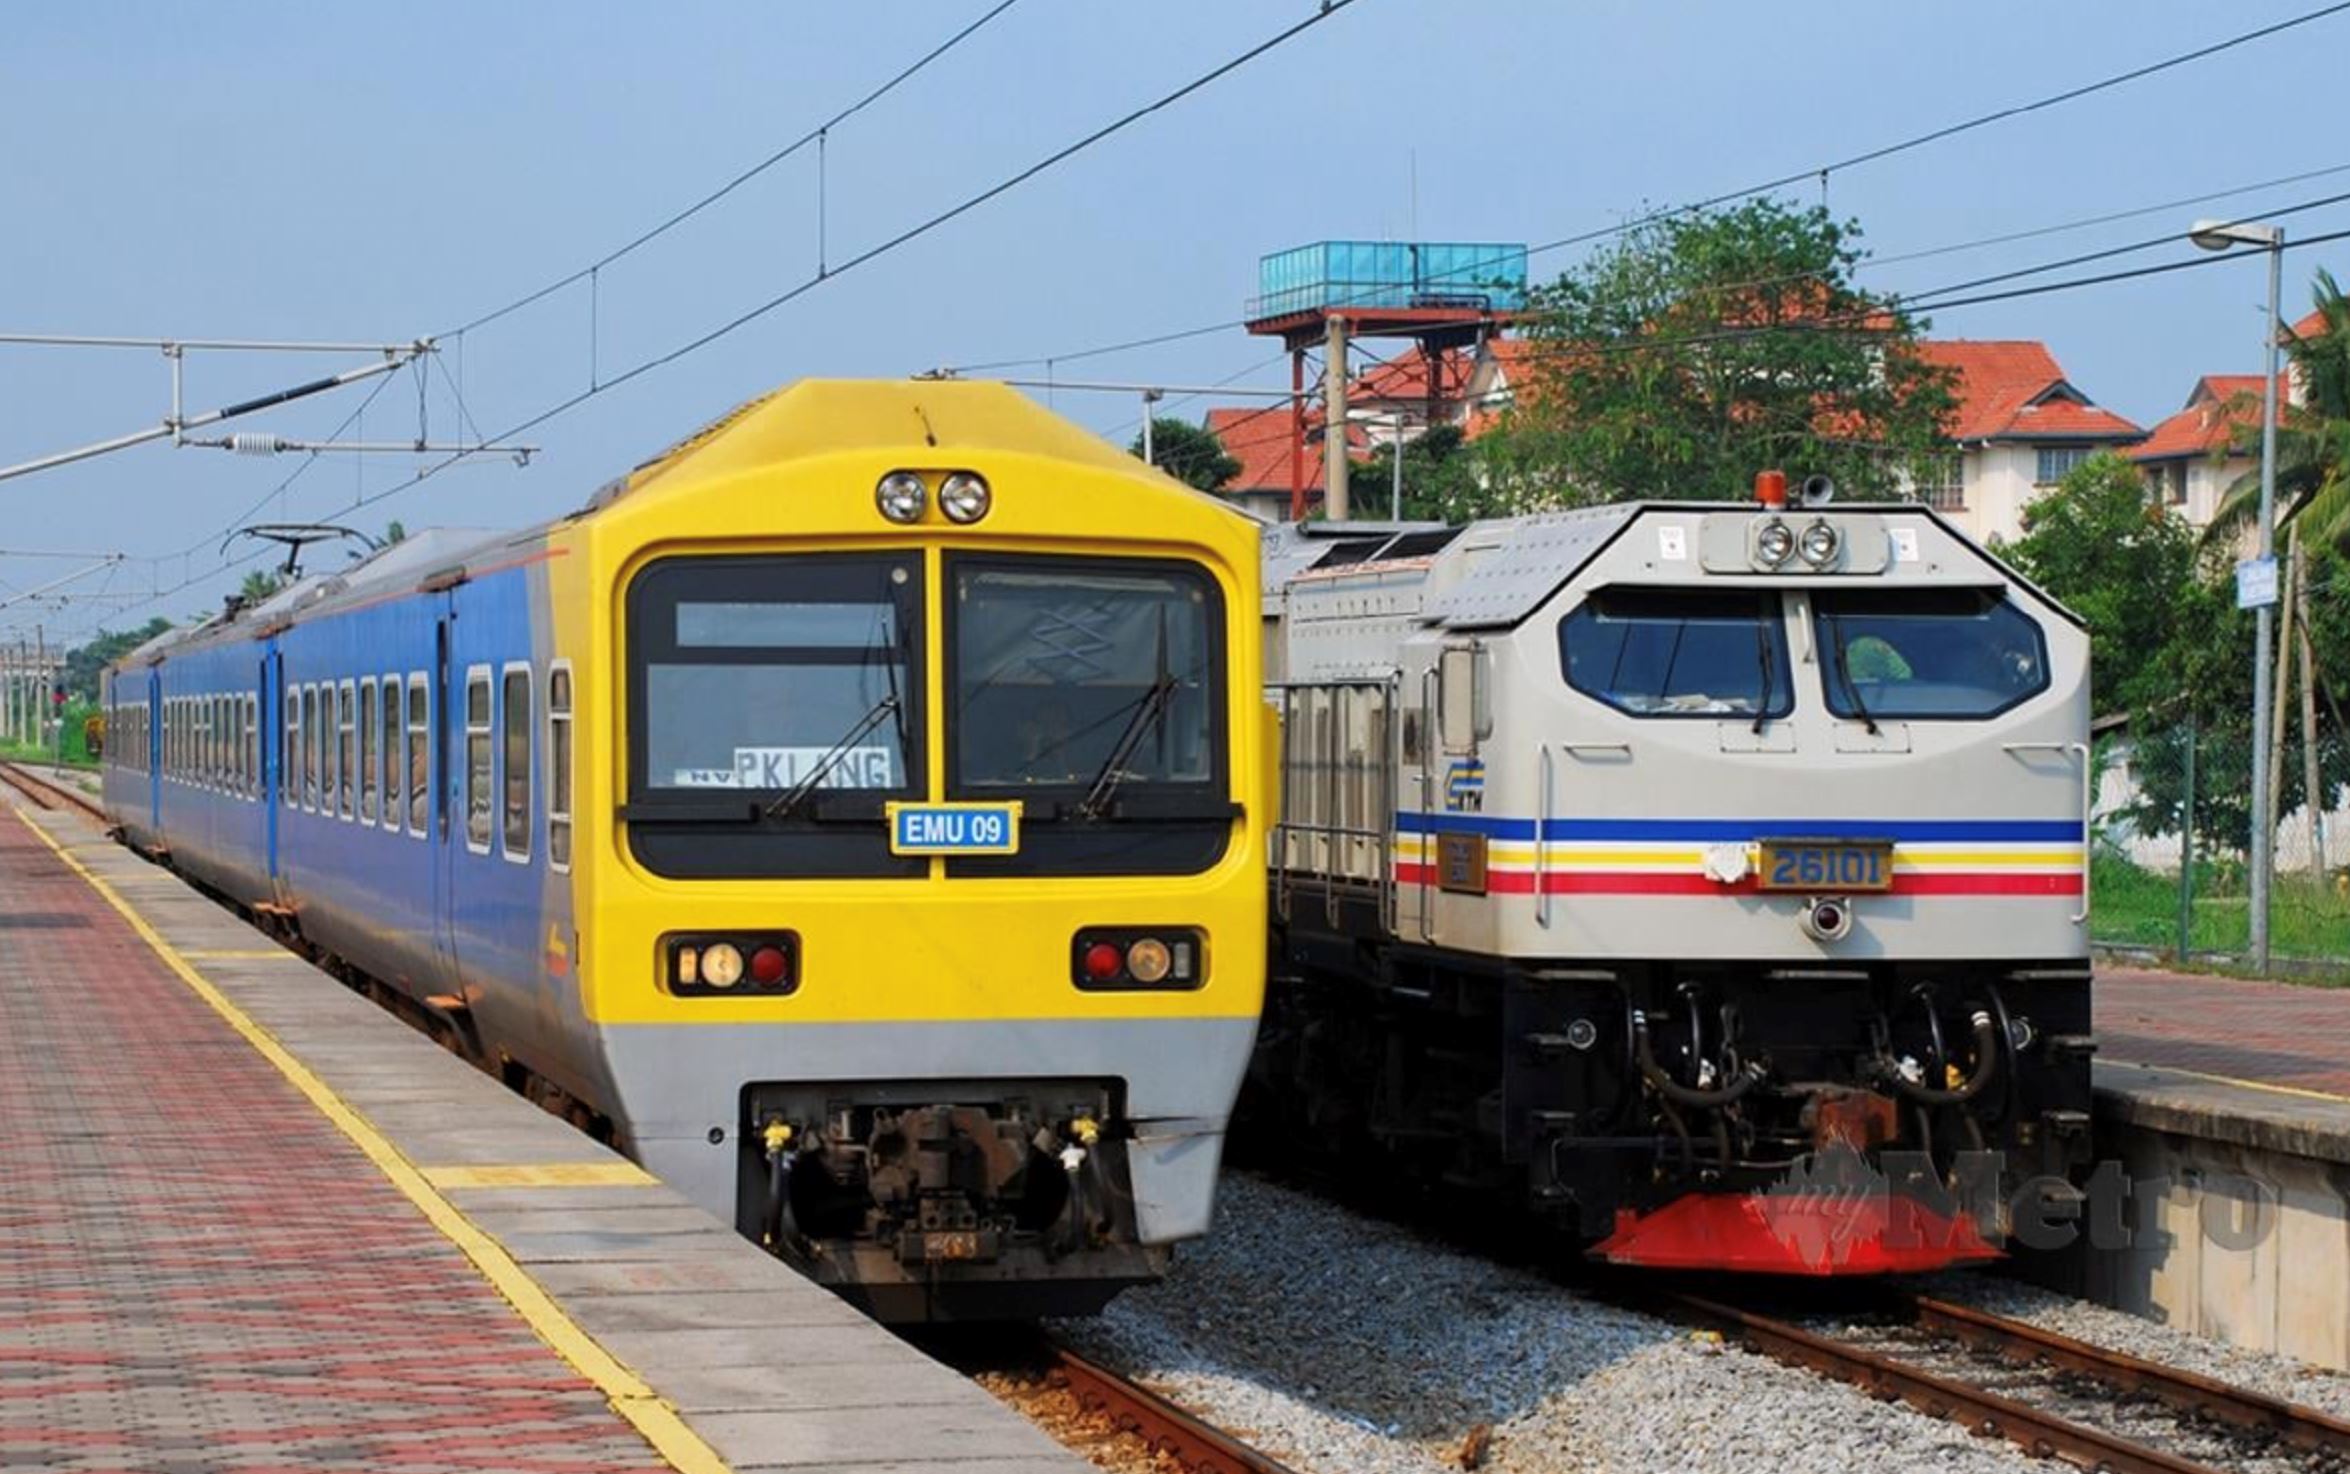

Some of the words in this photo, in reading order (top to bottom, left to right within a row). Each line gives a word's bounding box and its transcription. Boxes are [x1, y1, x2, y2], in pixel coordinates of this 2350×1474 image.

[907, 815, 964, 842] EMU
[972, 815, 1001, 842] 09
[1773, 849, 1881, 884] 26101
